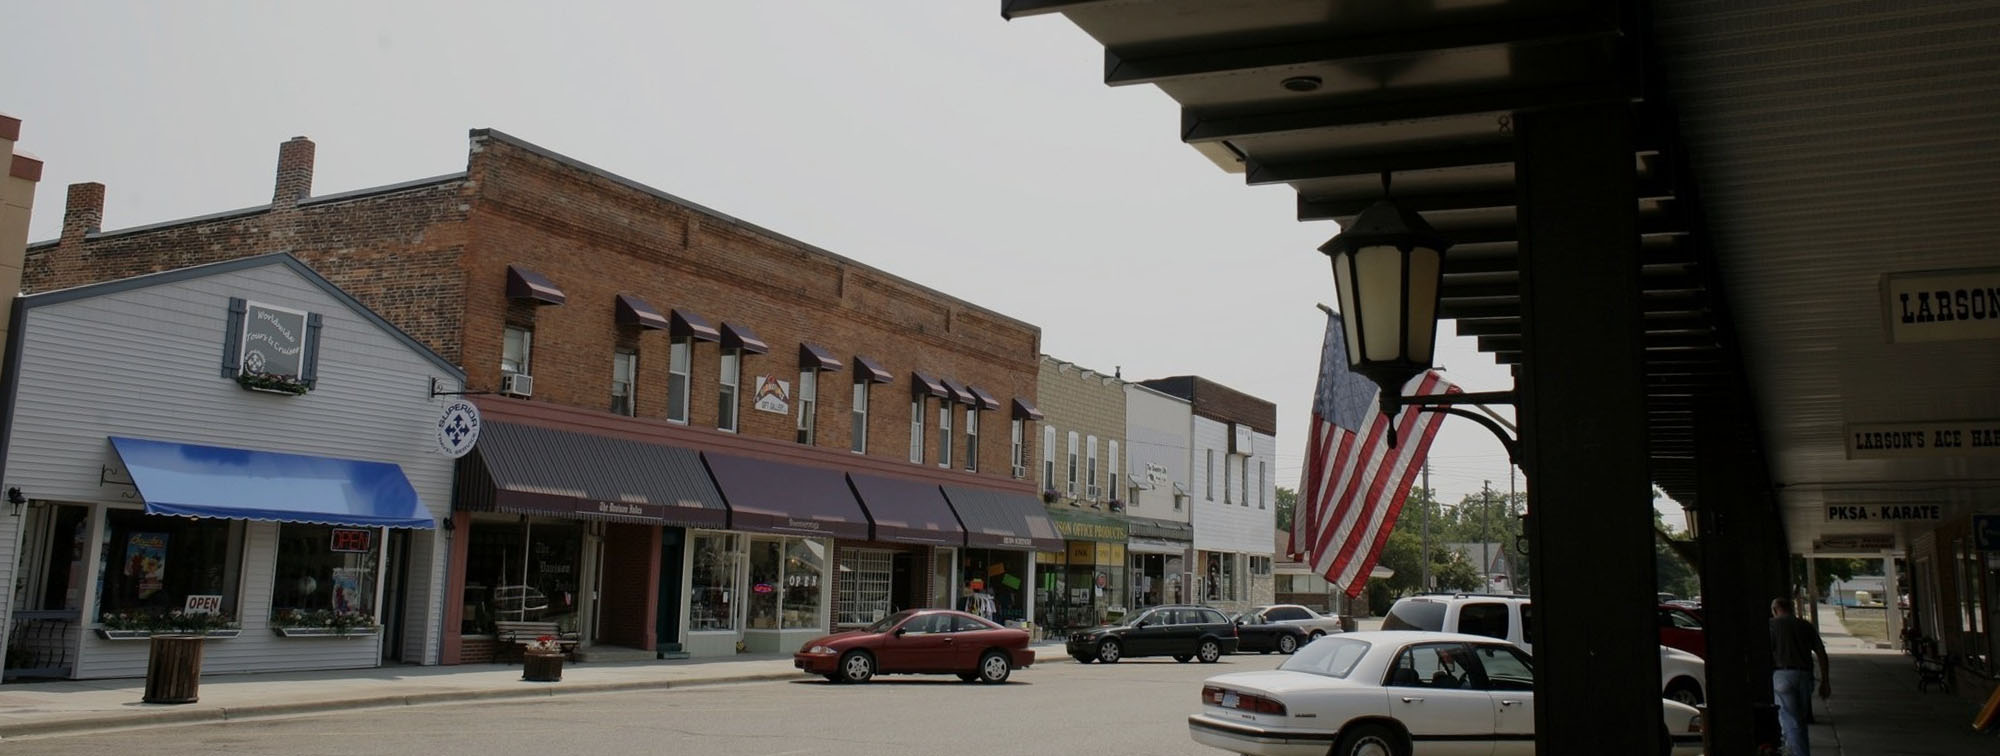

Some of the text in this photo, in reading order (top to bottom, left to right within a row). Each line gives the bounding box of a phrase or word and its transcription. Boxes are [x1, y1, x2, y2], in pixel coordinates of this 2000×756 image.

[257, 310, 296, 343] Worldwide
[246, 331, 267, 342] Tours
[438, 403, 478, 428] SUPERIOR
[1855, 431, 1925, 449] LARSON'S
[1934, 430, 1961, 447] ACE
[1829, 506, 1867, 520] PKSA
[1881, 505, 1939, 519] KARATE
[1073, 522, 1095, 537] OFFICE
[1095, 524, 1125, 540] PRODUCTS
[334, 531, 368, 550] OPEN
[789, 575, 817, 587] OPEN
[189, 597, 219, 610] OPEN
